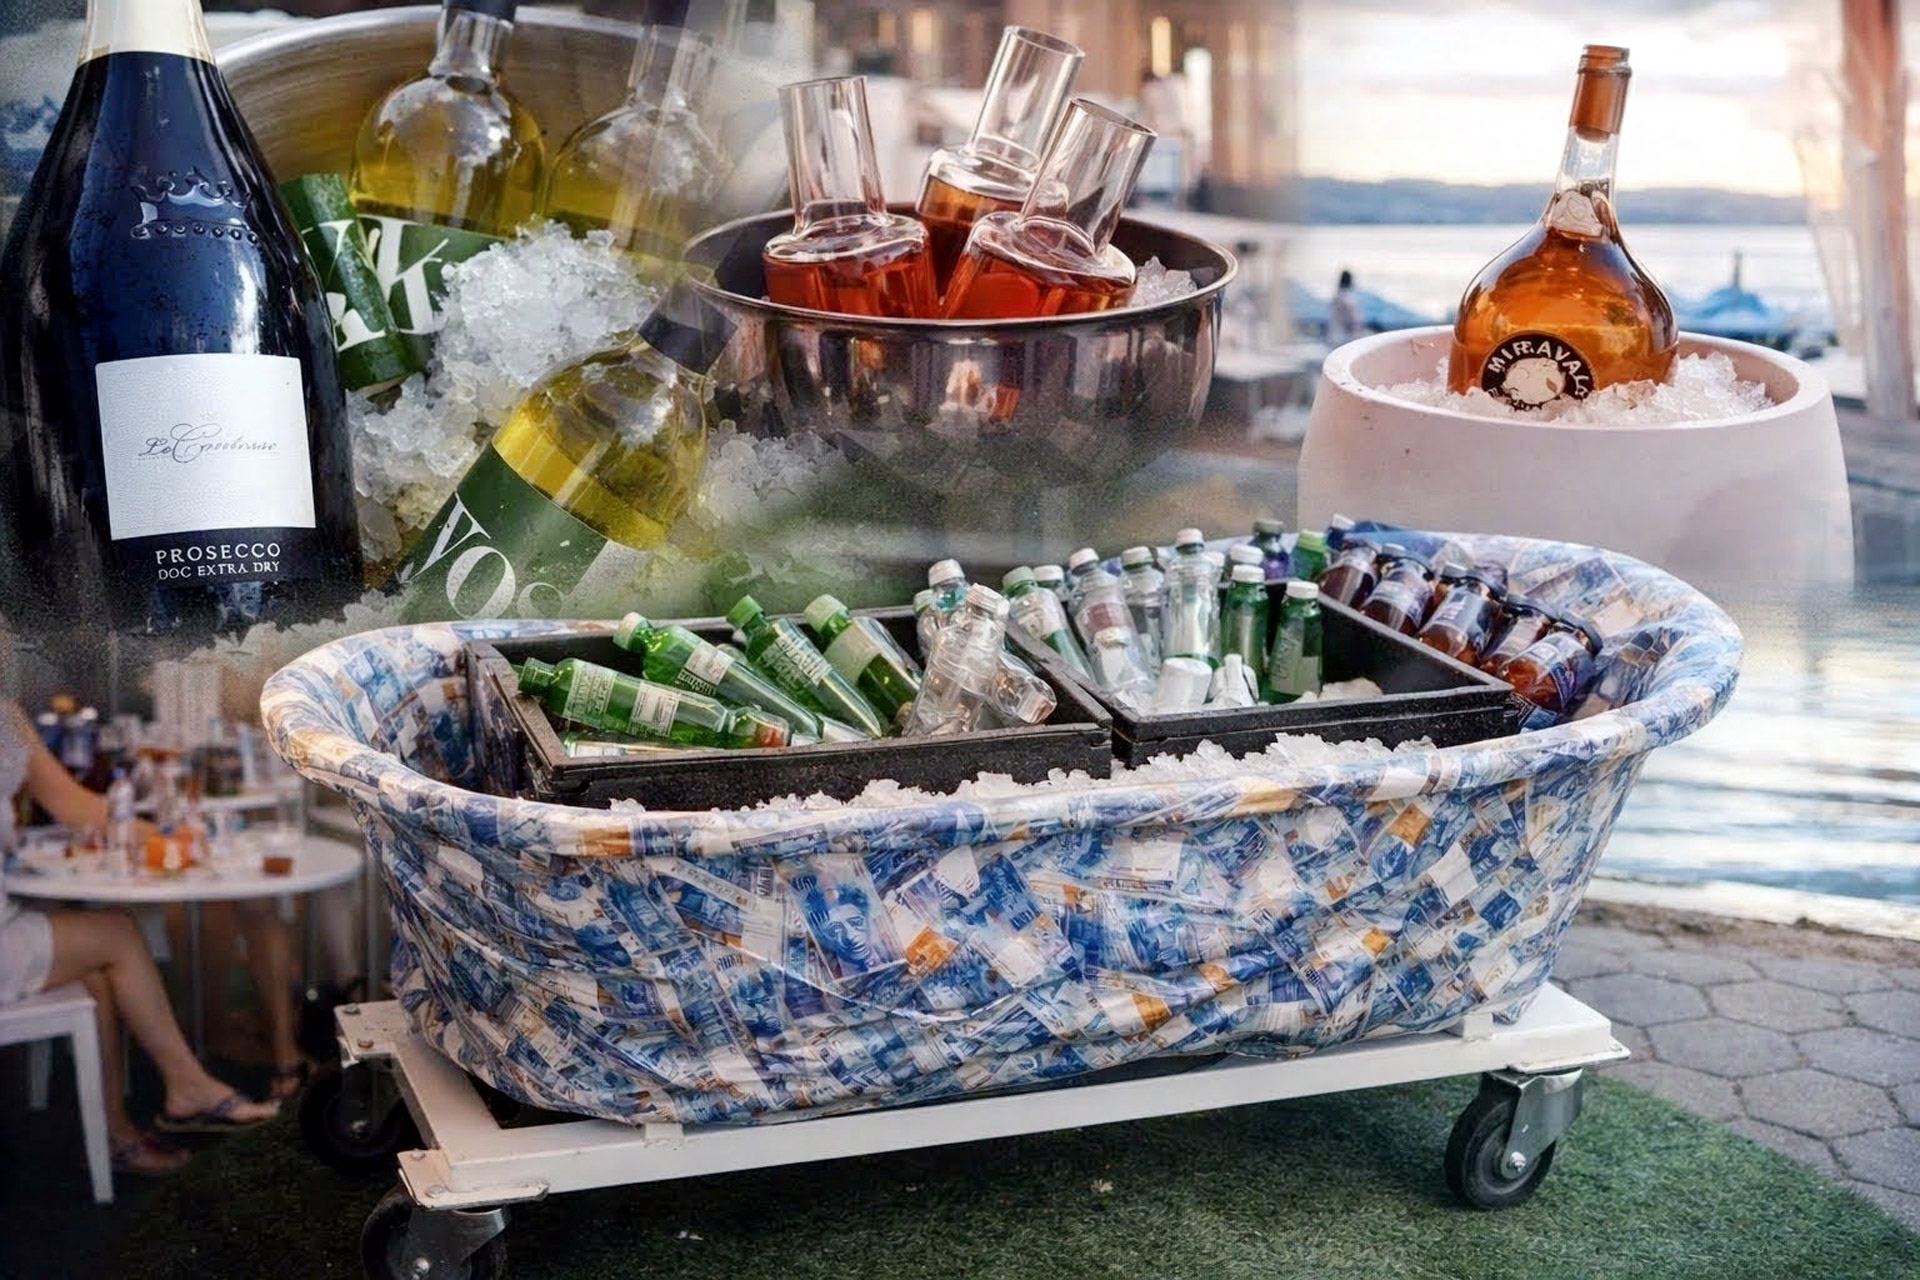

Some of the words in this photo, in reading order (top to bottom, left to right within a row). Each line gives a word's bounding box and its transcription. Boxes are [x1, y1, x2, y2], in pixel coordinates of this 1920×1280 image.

[155, 543, 281, 565] PROSECCO
[158, 566, 192, 580] DOC
[197, 563, 248, 576] EXTRA
[253, 561, 280, 573] DRY
